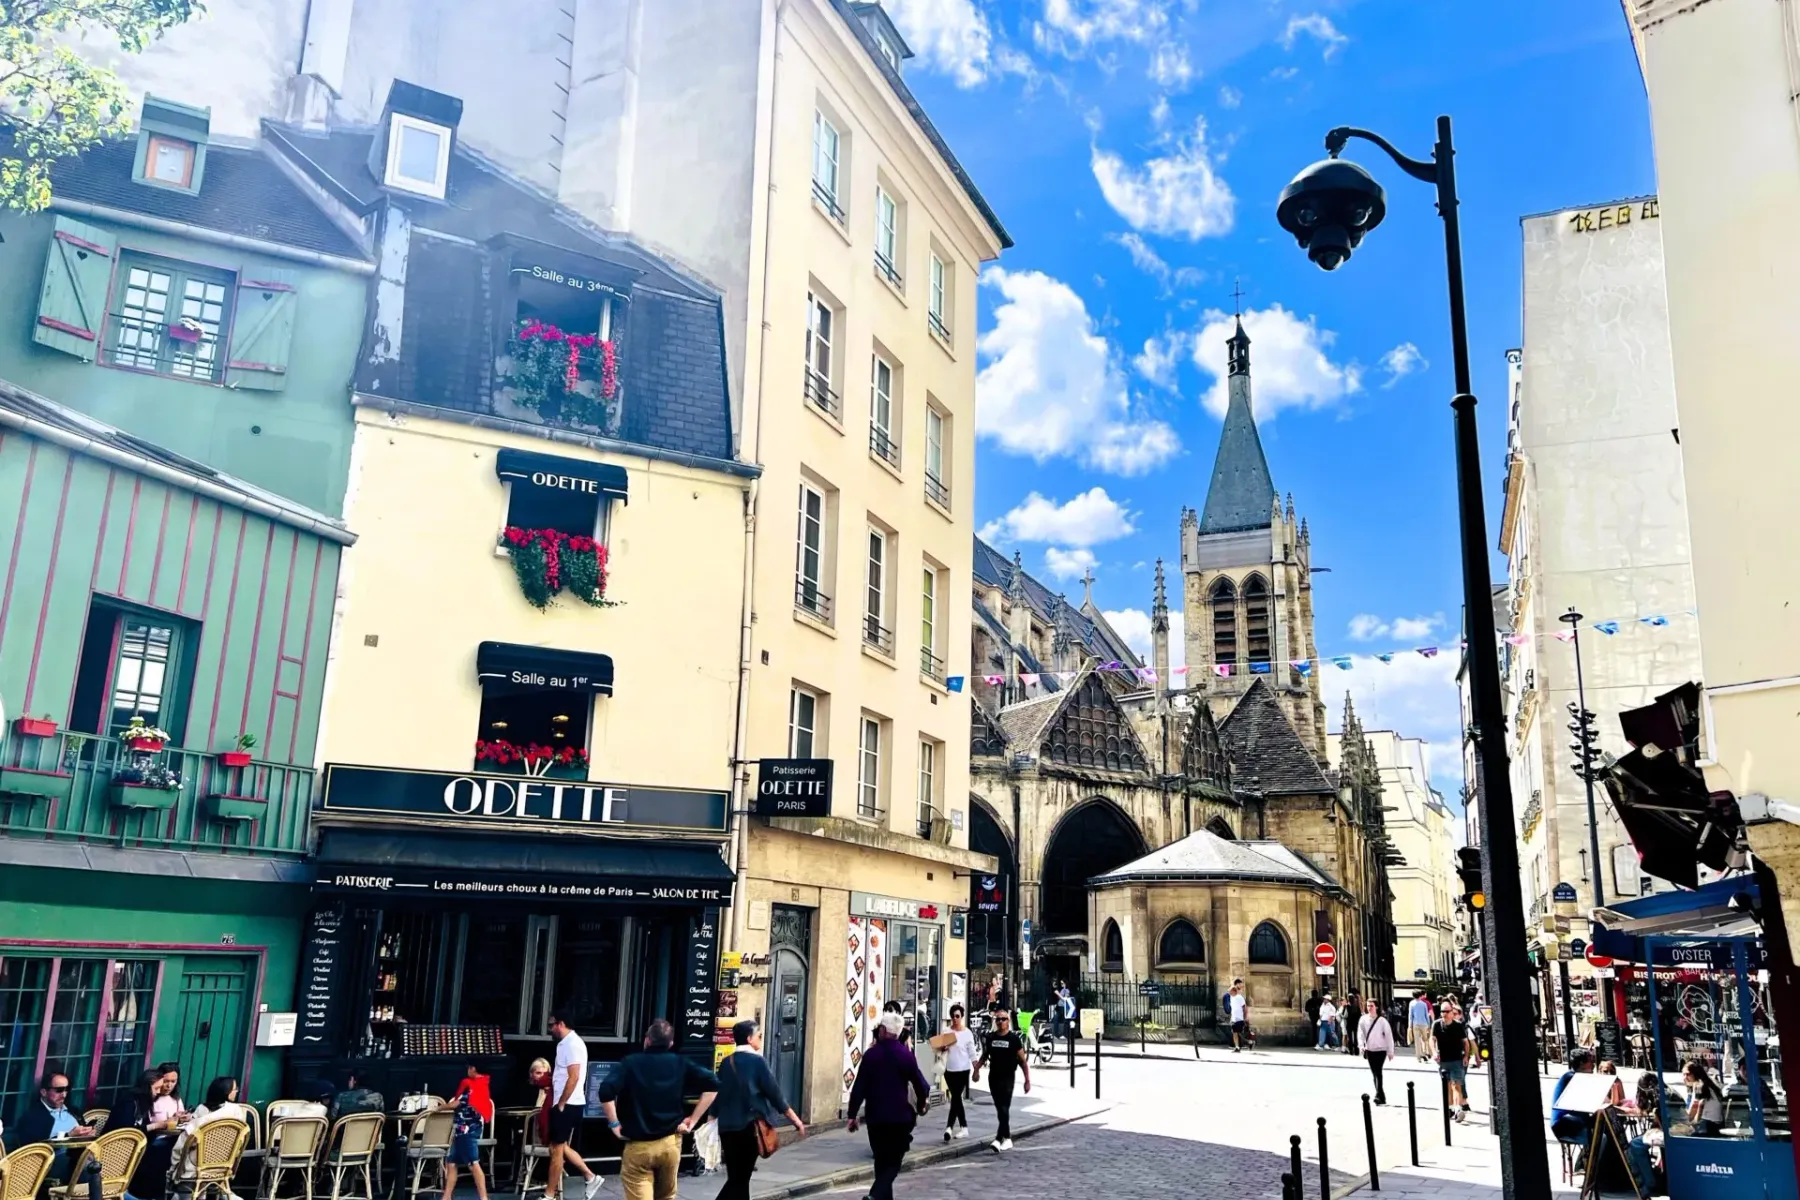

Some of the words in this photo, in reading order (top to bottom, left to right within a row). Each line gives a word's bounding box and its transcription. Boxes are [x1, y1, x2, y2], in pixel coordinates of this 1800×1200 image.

[532, 266, 564, 283] Salle
[567, 277, 584, 289] au
[532, 472, 599, 494] ODETTE
[511, 670, 546, 686] Salle
[550, 677, 567, 687] au
[572, 676, 589, 688] 1er
[772, 766, 816, 775] Patisserie
[760, 779, 826, 796] ODETTE
[443, 777, 628, 823] ODETTE
[777, 800, 806, 811] PARIS
[335, 875, 394, 890] PATISSERIE
[434, 880, 453, 890] Les
[456, 880, 504, 893] meilleurs
[506, 882, 538, 894] choux
[548, 884, 558, 894] la
[593, 885, 606, 896] de
[608, 886, 634, 897] Paris
[652, 888, 683, 899] SALON
[685, 889, 699, 899] DE
[978, 902, 999, 912] soupe
[222, 934, 235, 945] 75
[1672, 949, 1712, 961] OYSTER
[686, 1008, 701, 1018] Salle
[1695, 1162, 1735, 1175] LAVAZZA
